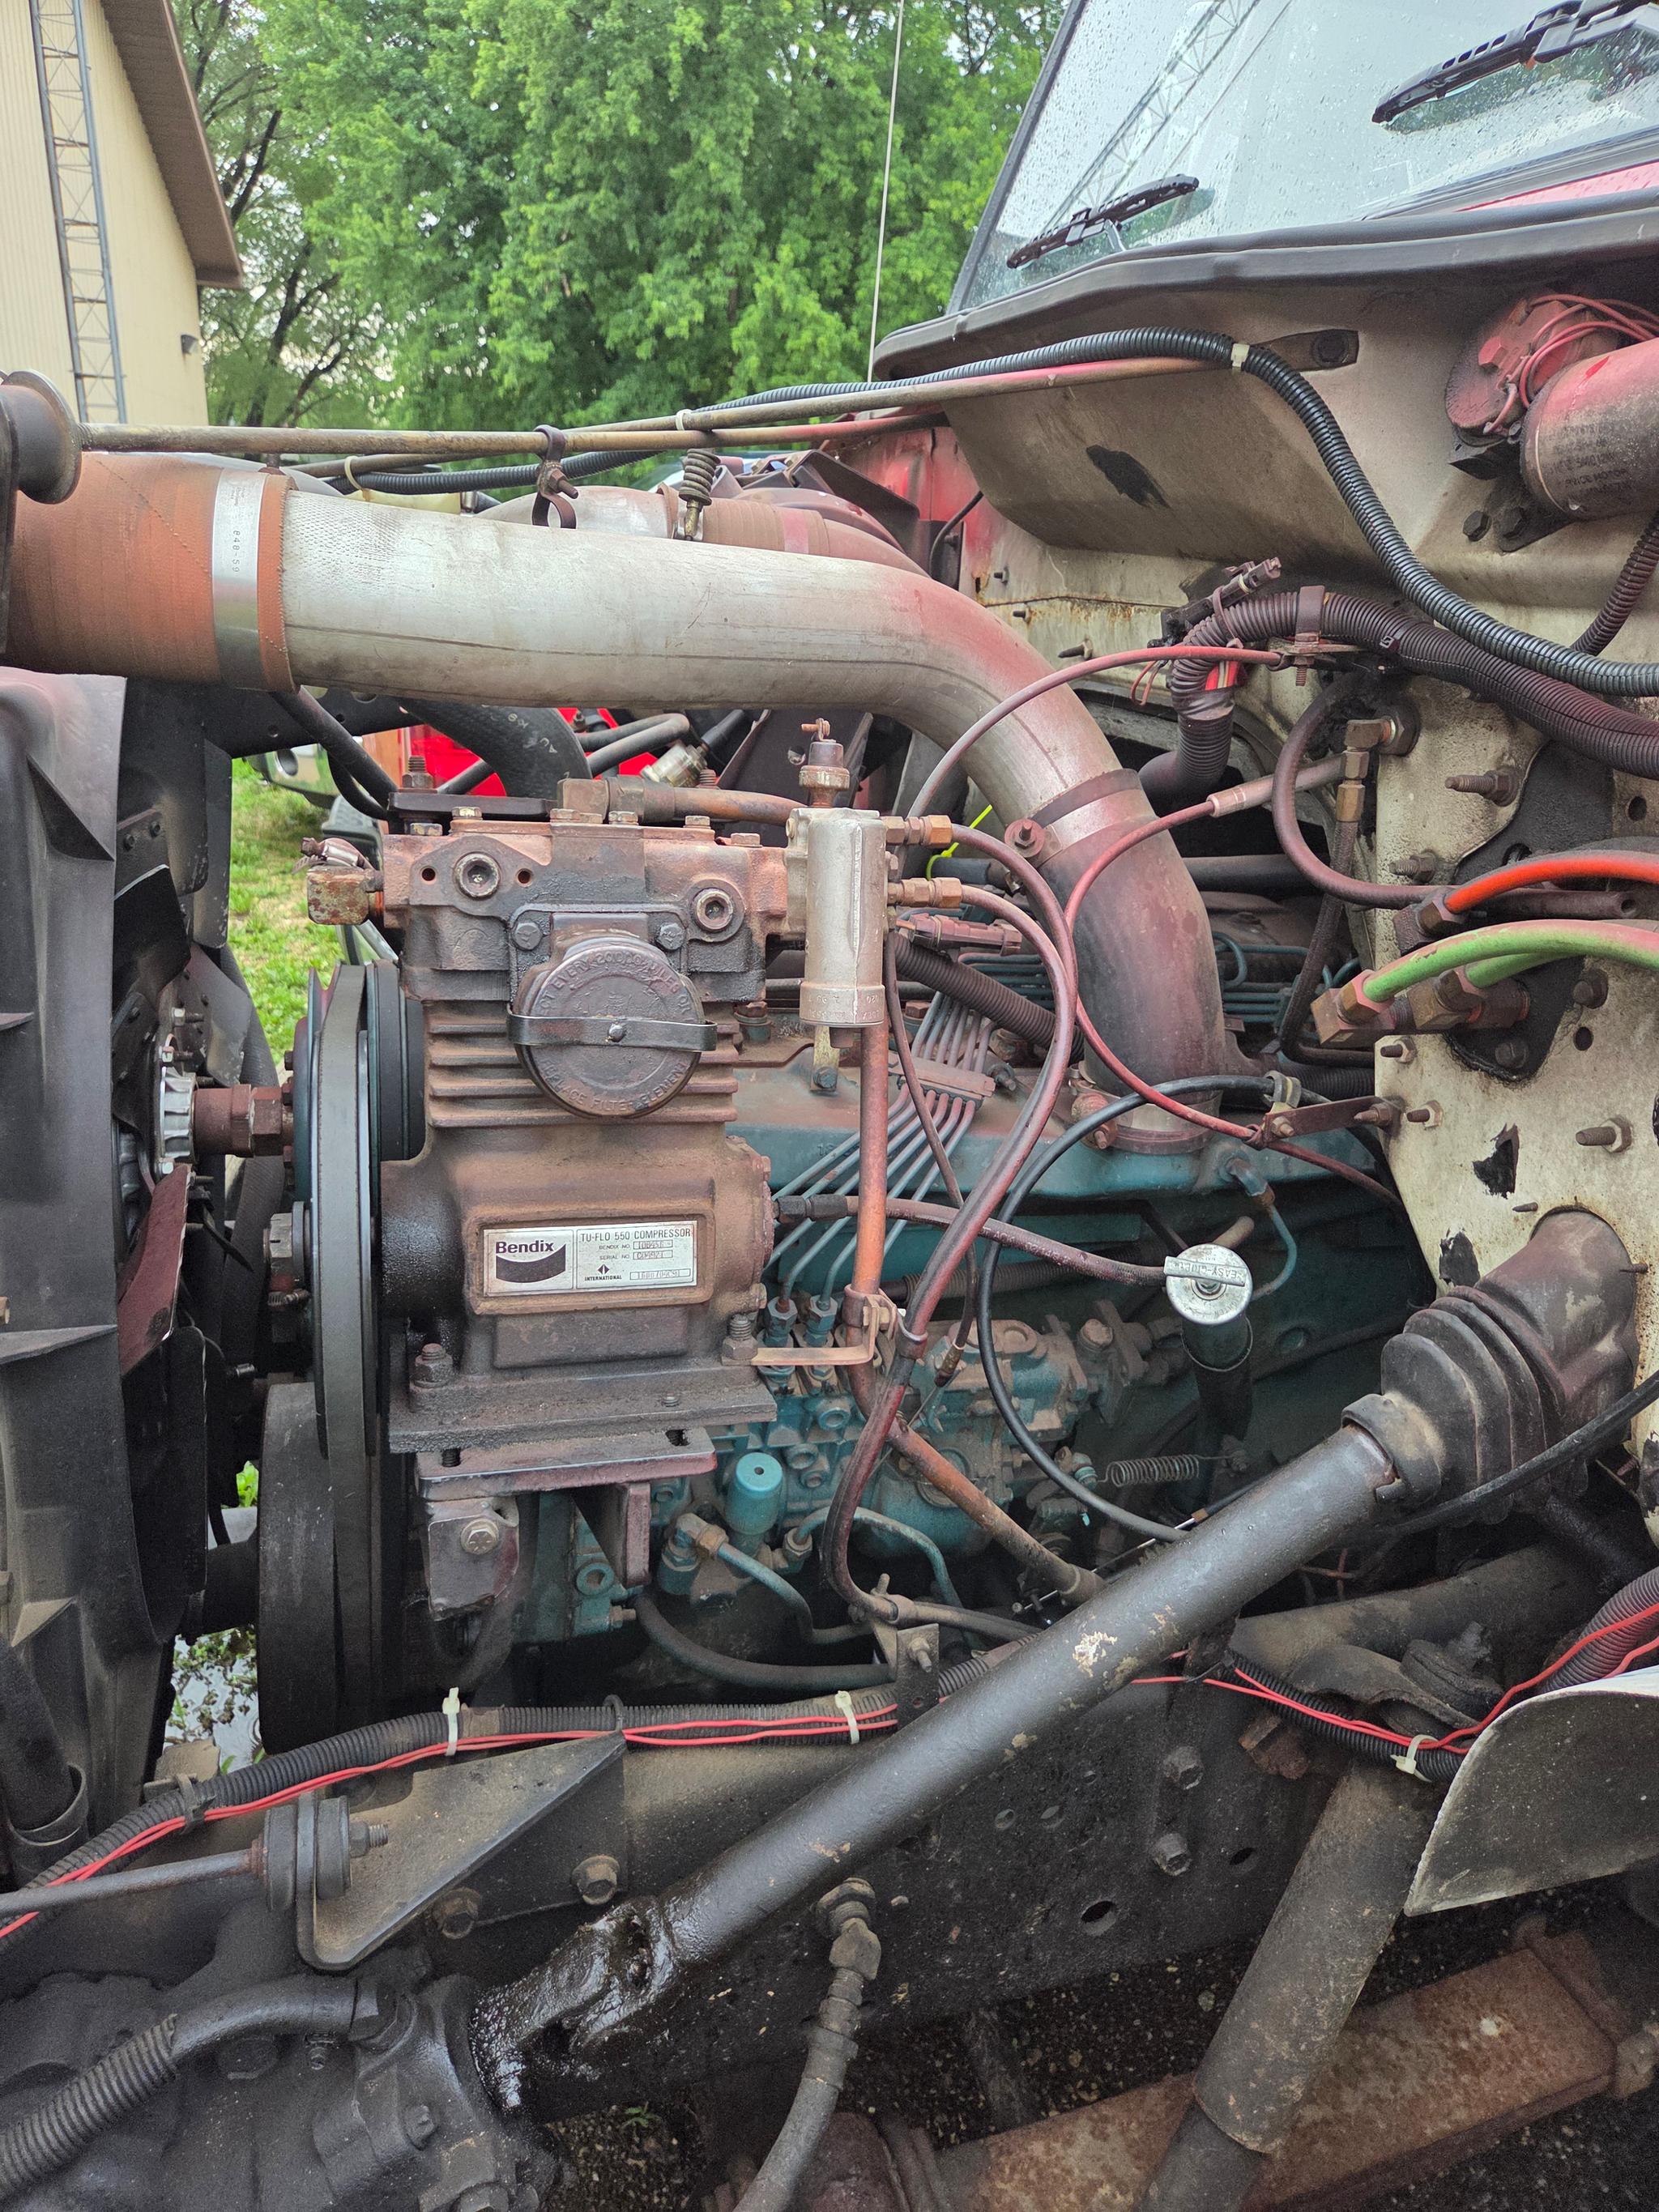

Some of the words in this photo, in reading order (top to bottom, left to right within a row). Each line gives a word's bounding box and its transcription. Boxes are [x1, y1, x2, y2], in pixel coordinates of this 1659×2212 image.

[615, 1231, 630, 1241] 550
[633, 1228, 692, 1240] COMPRESSOR
[495, 1240, 555, 1255] Bendix
